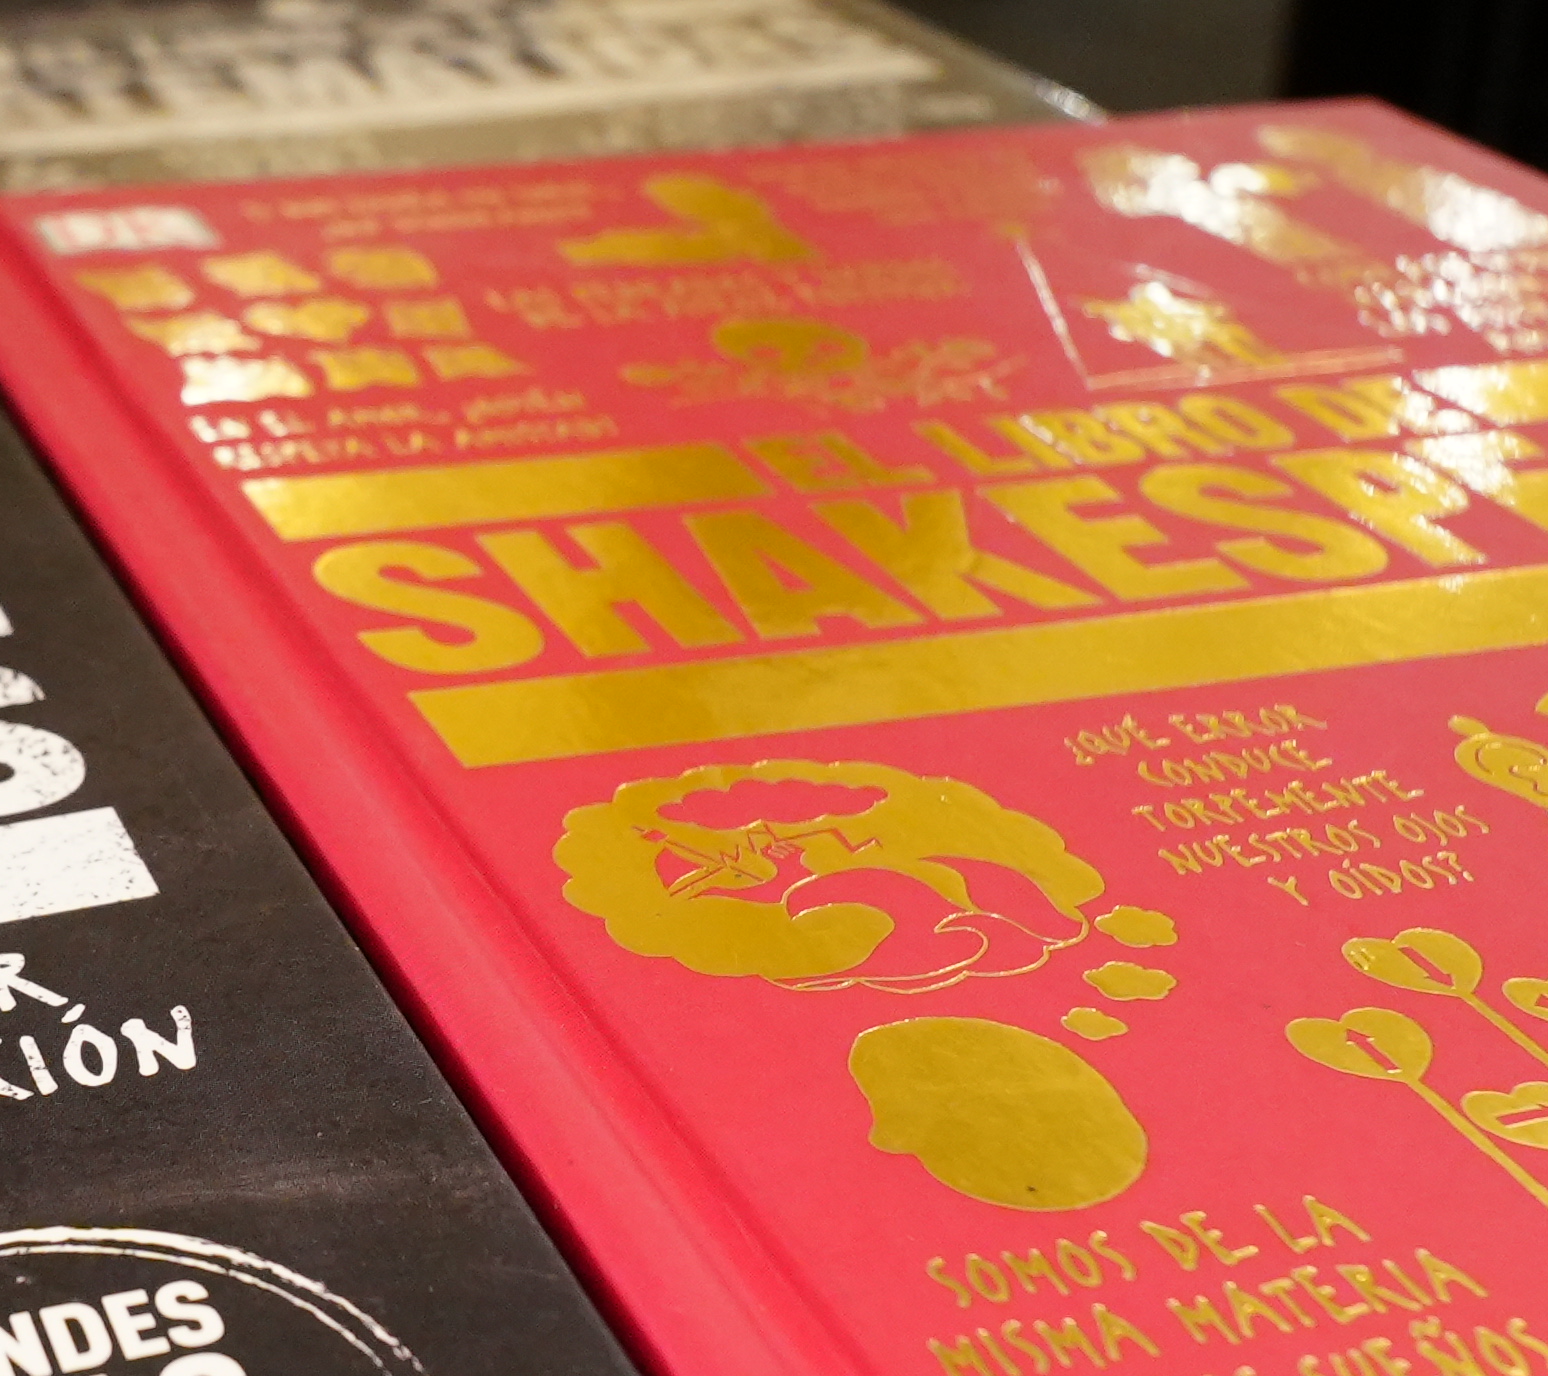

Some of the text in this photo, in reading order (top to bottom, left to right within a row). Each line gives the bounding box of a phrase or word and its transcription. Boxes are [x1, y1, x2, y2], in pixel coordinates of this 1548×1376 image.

[740, 430, 940, 493] EL
[910, 394, 1298, 480] LIBRO
[1187, 702, 1328, 745] ERROR
[1135, 737, 1335, 788] CONDUCE
[1131, 768, 1427, 834] TORPEMENTE
[1157, 803, 1492, 880] NUESTROS OJOS
[1266, 849, 1484, 907] Y OÍDOS?
[926, 1193, 1375, 1309] SOMOS DE LA
[1164, 1246, 1489, 1345] MATERIA
